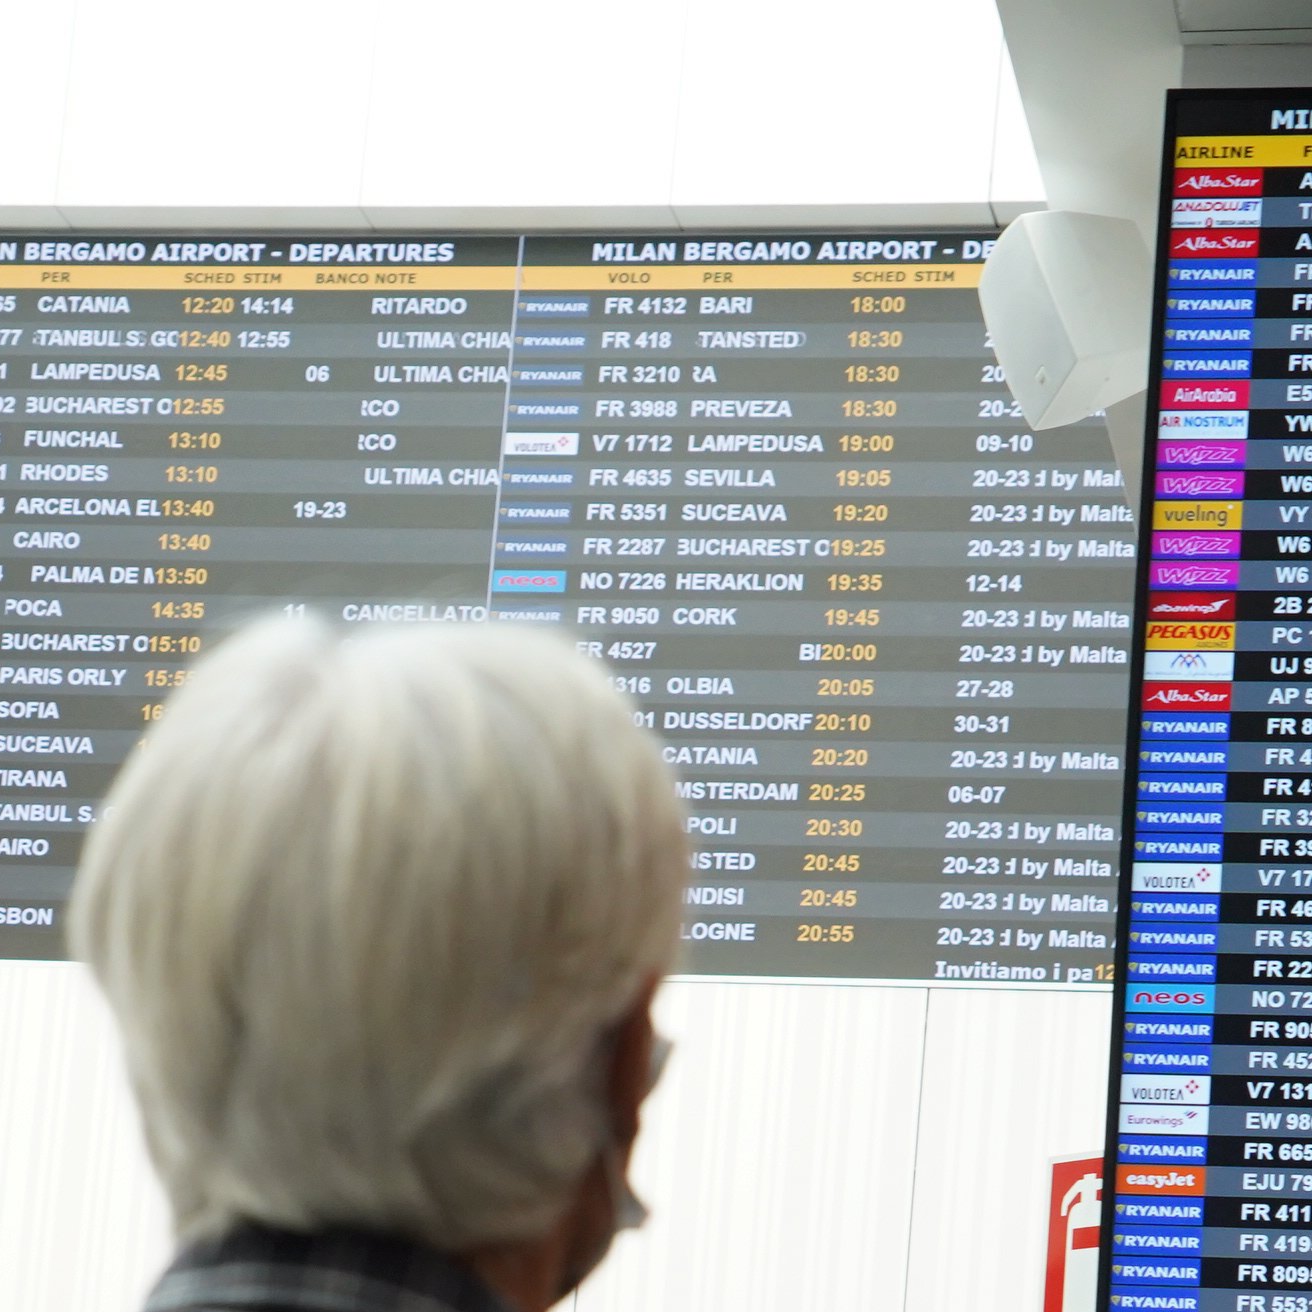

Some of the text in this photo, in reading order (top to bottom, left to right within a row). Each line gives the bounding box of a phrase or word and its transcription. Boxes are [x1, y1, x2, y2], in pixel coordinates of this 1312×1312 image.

[1176, 145, 1254, 159] AIRLINE
[25, 243, 145, 261] BERGAMO
[151, 243, 265, 261] AIRPORT
[290, 244, 453, 261] DEPARTURES
[41, 271, 70, 283] PER
[184, 272, 235, 284] SCHED
[243, 272, 282, 284] STIM
[315, 272, 369, 285] BANCO
[375, 272, 417, 284] NOTE
[38, 296, 129, 312] CATANIA
[183, 298, 234, 313] 12:20
[242, 298, 293, 313] 14:14
[372, 298, 466, 314] RITARDO
[1178, 299, 1252, 310] RYANAIR
[593, 435, 1032, 451] V7 1712 LAMPEDUSA 19:00 09-10
[1164, 507, 1230, 528] vueling
[1280, 506, 1309, 522] VY
[1278, 537, 1310, 552] W6
[1146, 624, 1231, 642] PEGASUS
[1271, 658, 1298, 674] UJ
[1152, 720, 1227, 736] RYANAIR
[1267, 718, 1296, 734] FR
[1132, 990, 1205, 1005] neos
[1252, 991, 1285, 1007] NO
[1126, 1170, 1196, 1191] easyJet
[1243, 1174, 1284, 1193] EJU
